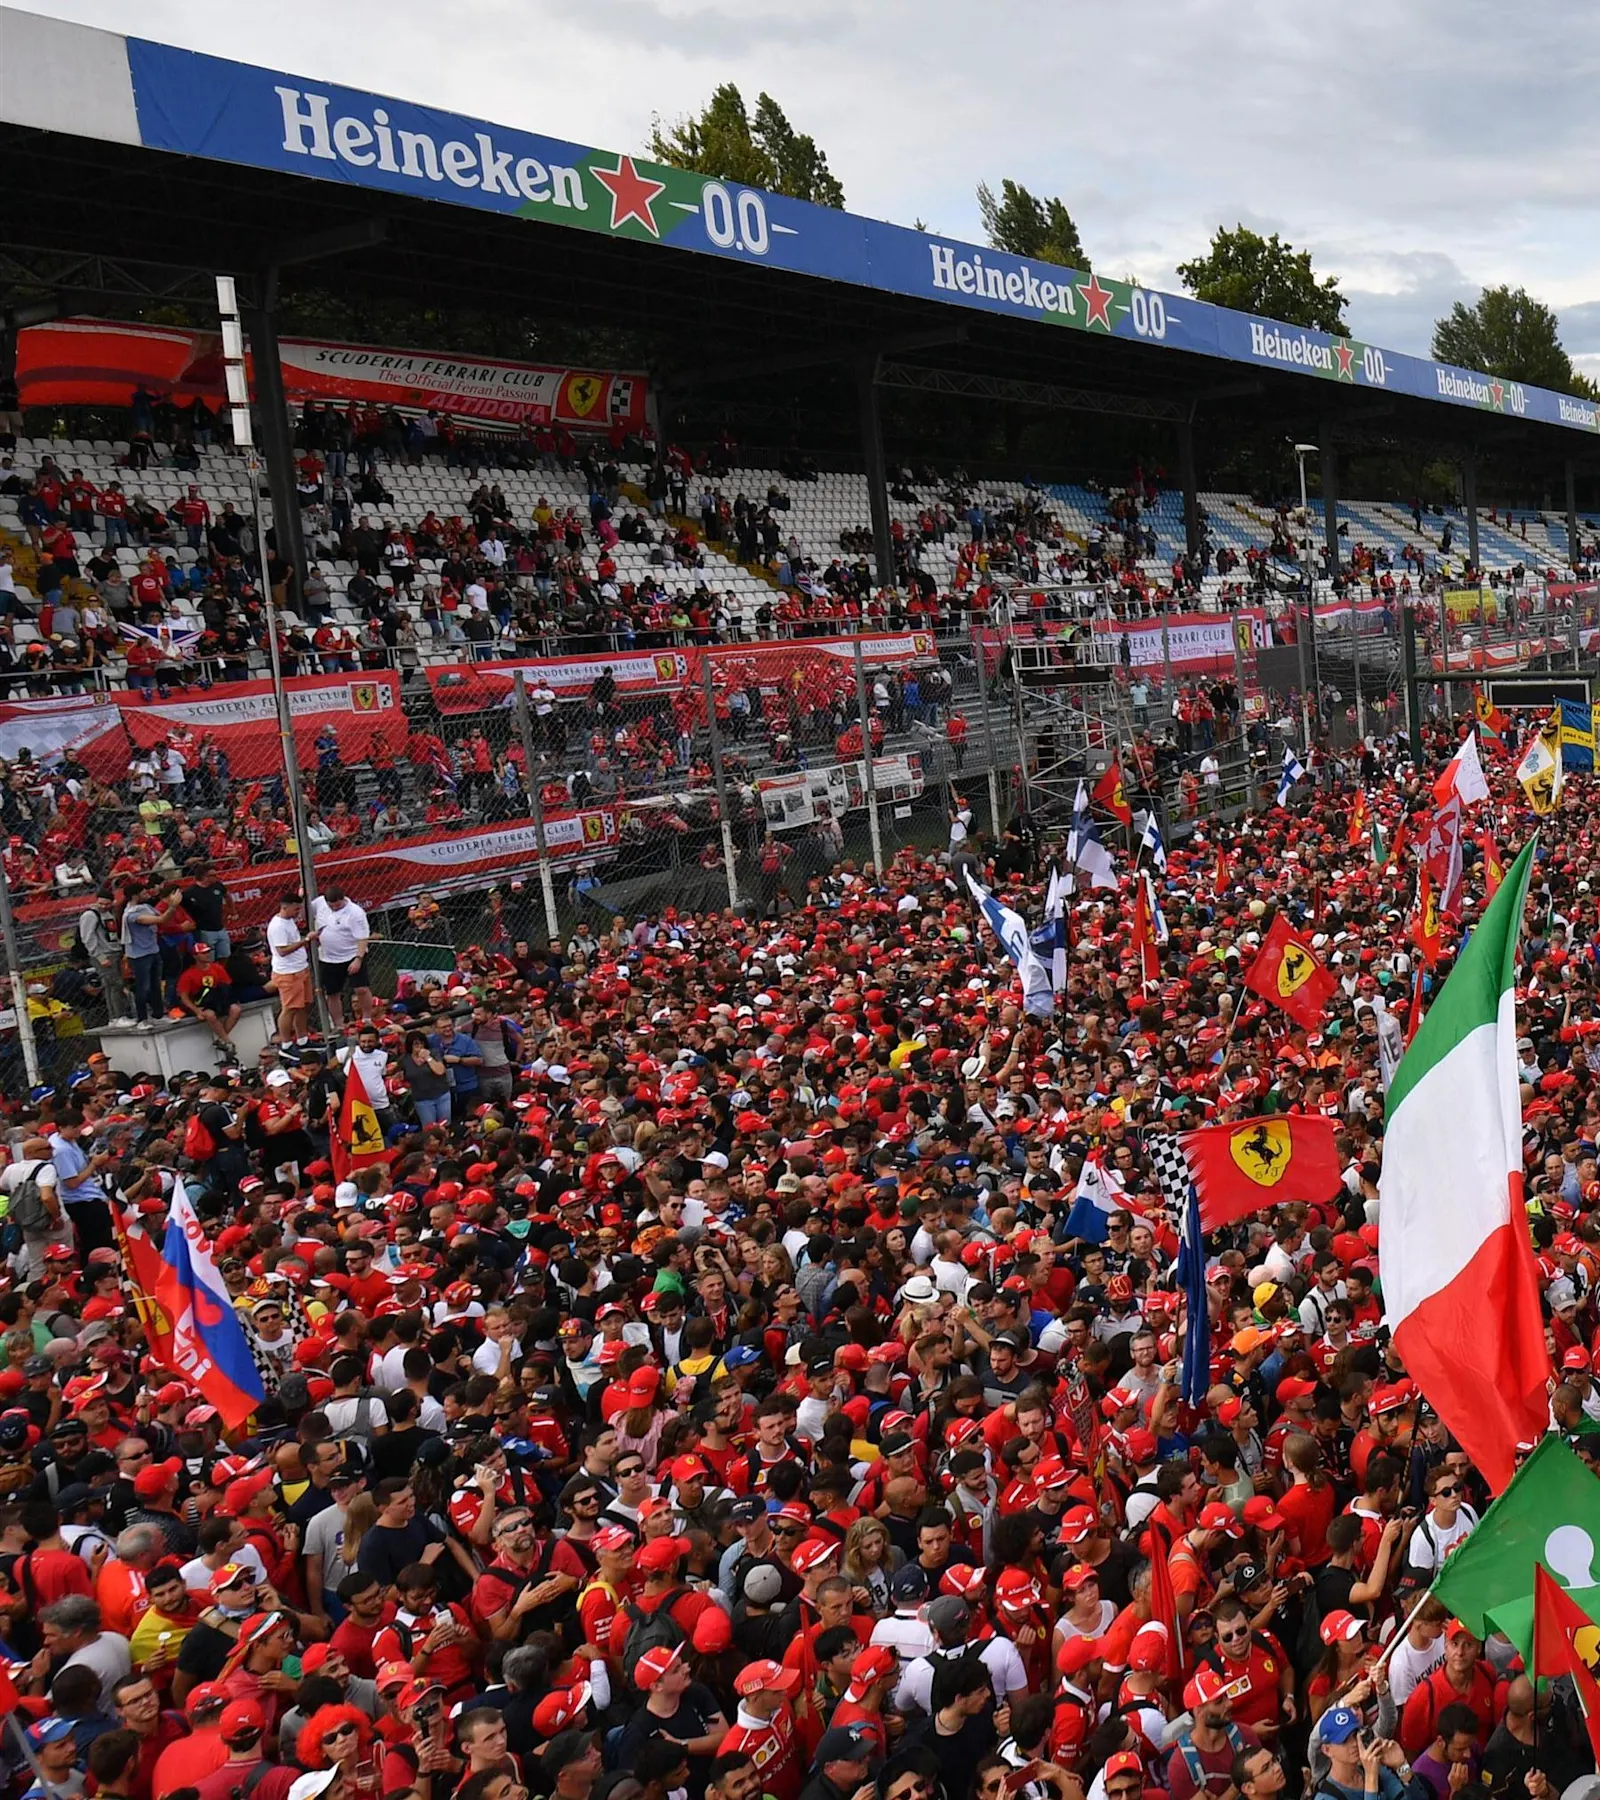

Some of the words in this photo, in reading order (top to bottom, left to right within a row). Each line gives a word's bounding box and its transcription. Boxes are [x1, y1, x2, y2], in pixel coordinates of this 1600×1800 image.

[274, 86, 588, 210] Heineken
[929, 243, 1076, 315] Heineken
[1250, 322, 1333, 370] Heineken
[315, 350, 413, 371] SCUDERIA
[421, 360, 496, 383] FERRARI
[503, 371, 545, 388] CLUB
[378, 368, 402, 383] The
[405, 371, 453, 390] Official
[455, 379, 493, 397] Ferrari
[496, 384, 539, 401] Passion
[1436, 368, 1490, 403] Heineken
[427, 393, 545, 423] ALTIDONA
[1558, 399, 1597, 427] Heineken
[1166, 631, 1200, 645] ERRARI
[1203, 629, 1226, 641] CLUB
[188, 699, 257, 717] SCUDERIA
[316, 689, 348, 705] CLUB
[431, 836, 493, 858] SCUDERIA
[498, 830, 539, 848] FERRAR
[547, 822, 575, 835] CLUB
